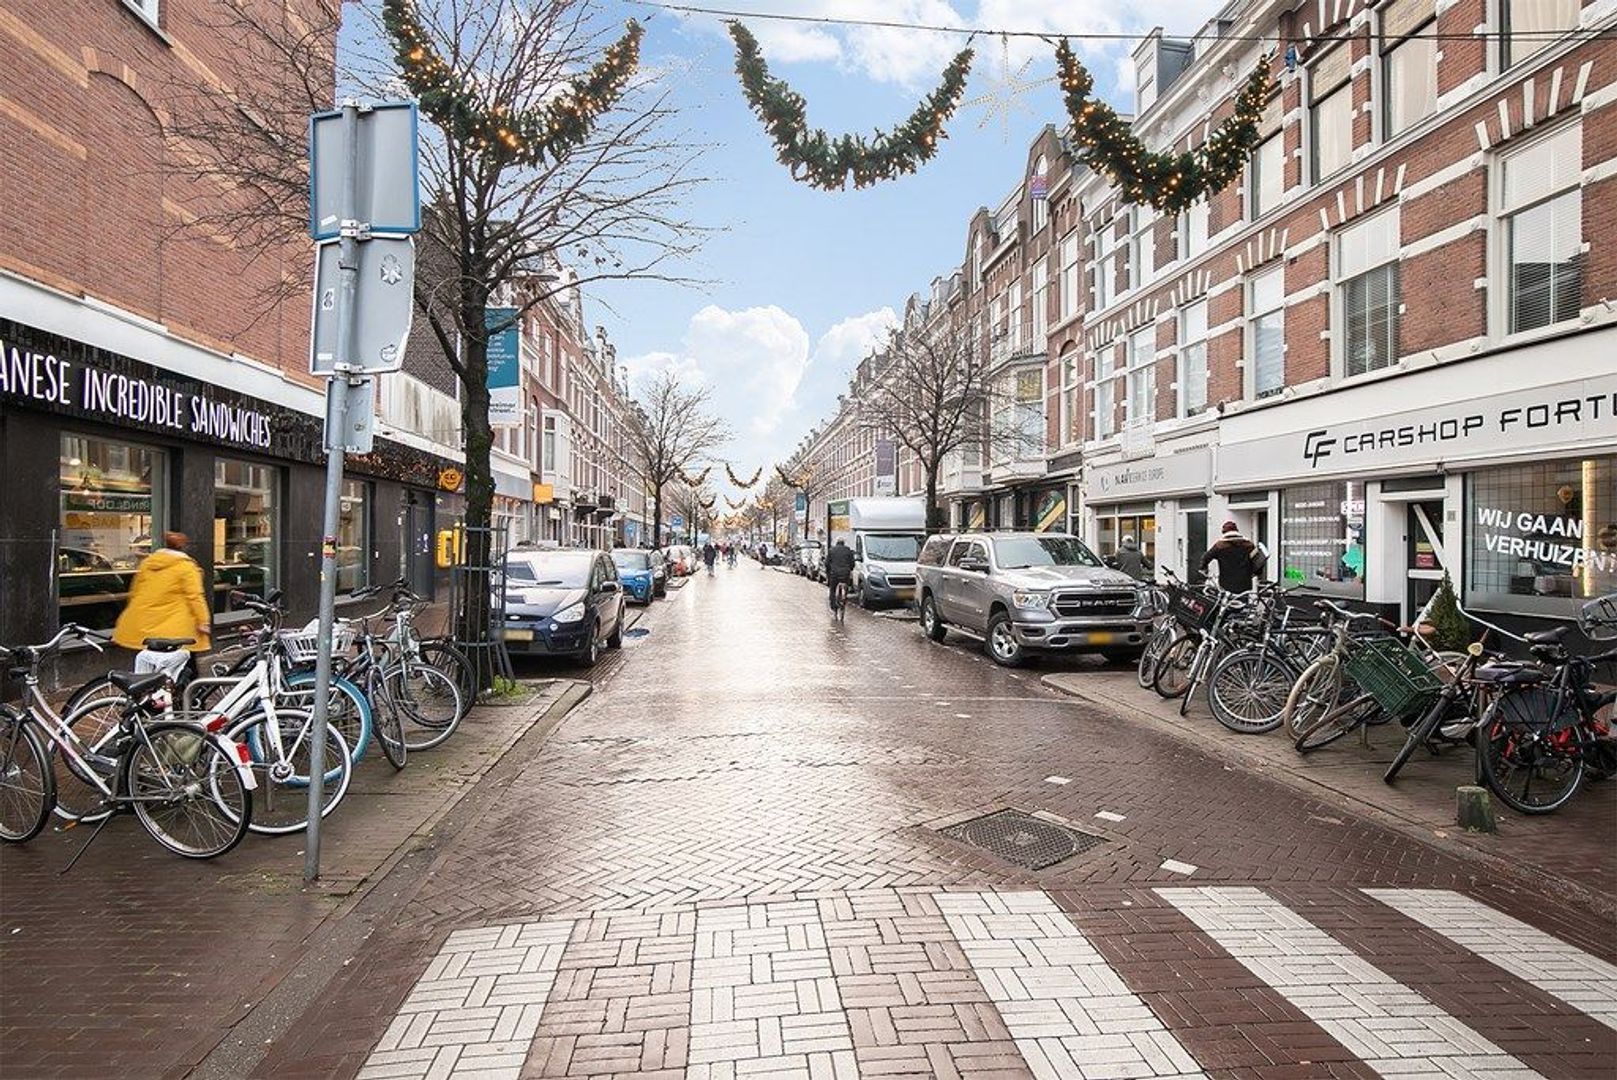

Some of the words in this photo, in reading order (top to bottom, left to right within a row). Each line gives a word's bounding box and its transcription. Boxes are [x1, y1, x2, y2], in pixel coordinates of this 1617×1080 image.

[84, 367, 183, 429] INCREDIBLE
[191, 395, 271, 448] SANDWICHES
[1344, 415, 1484, 454] CARSHOP
[1500, 392, 1617, 433] FORT
[1478, 507, 1512, 528] WIJ
[1517, 513, 1583, 538] GAAN
